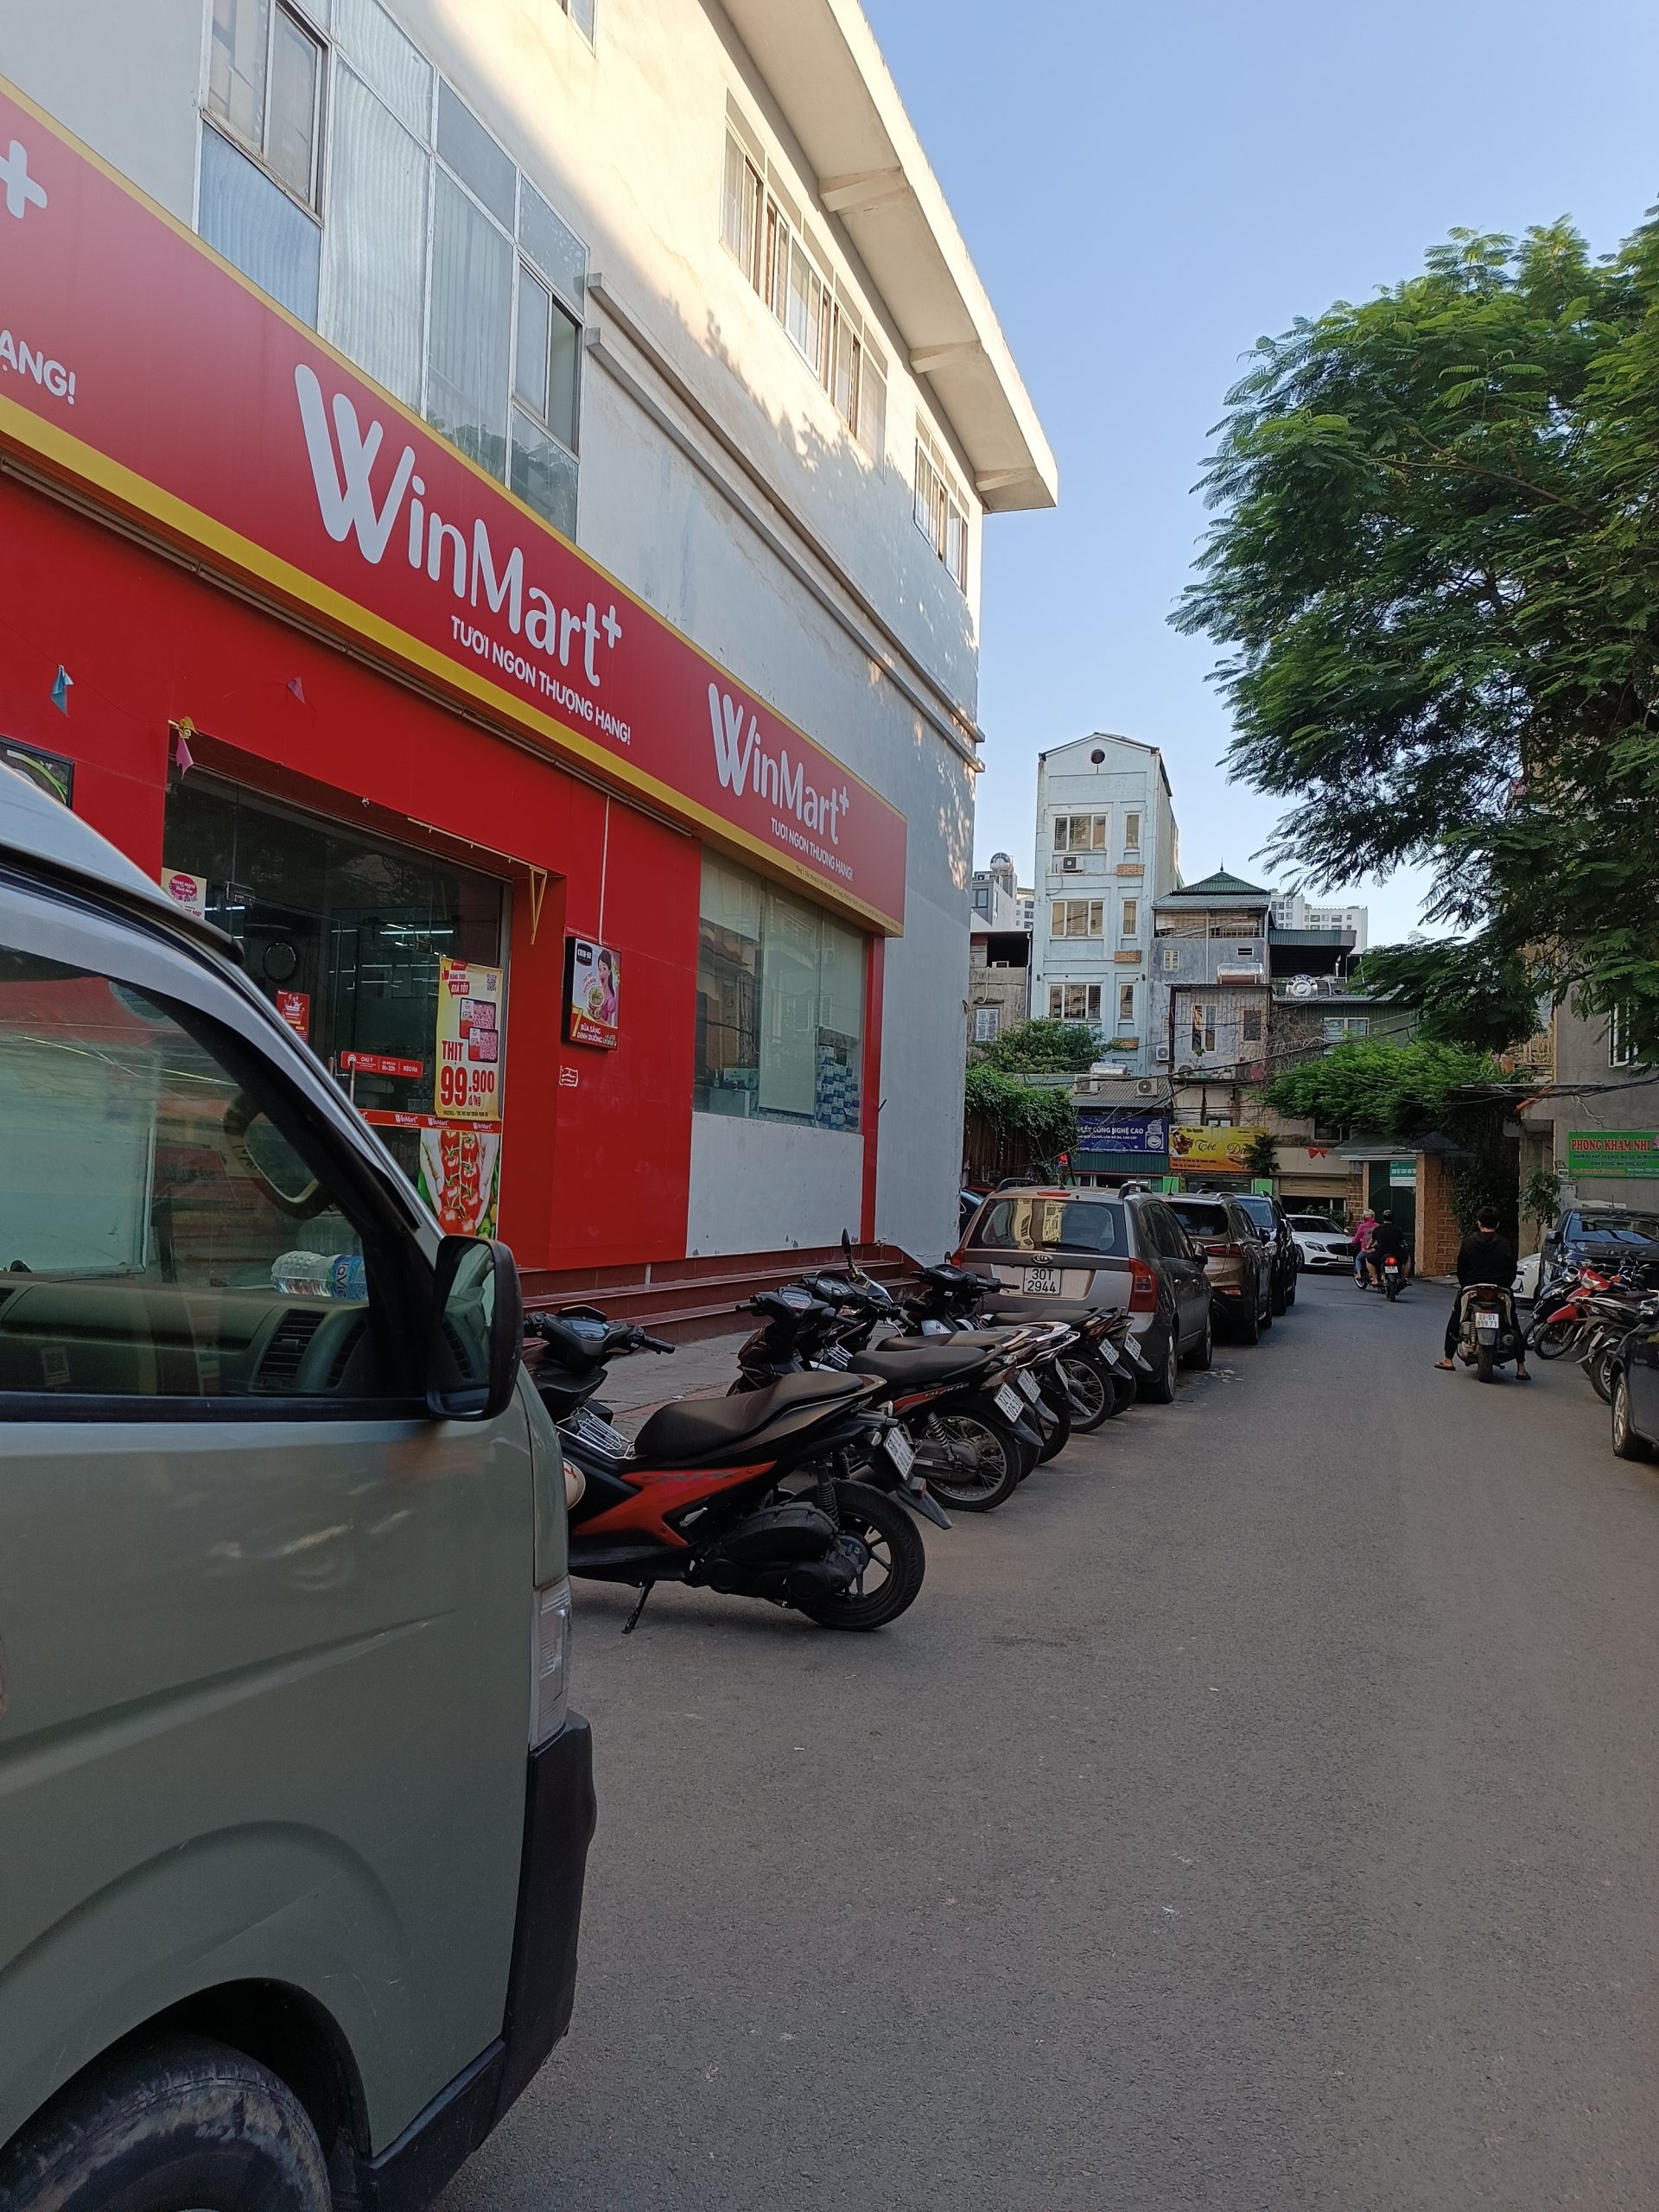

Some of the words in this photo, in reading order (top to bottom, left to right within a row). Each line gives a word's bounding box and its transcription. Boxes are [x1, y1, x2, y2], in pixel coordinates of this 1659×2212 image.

[0, 330, 75, 404] ẠNG!
[451, 615, 489, 658] TƯƠI
[493, 642, 536, 688] NGON
[539, 671, 593, 721] THƯỢNG
[595, 707, 631, 746] HẠNG!
[789, 829, 810, 855] NGON
[442, 1040, 463, 1065] THỊT
[1571, 1136, 1603, 1151] PHÒNG
[1604, 1135, 1631, 1151] KHÁM
[1633, 1139, 1650, 1152] NHI
[1027, 1281, 1056, 1293] 2944
[1033, 1268, 1054, 1281] 30T
